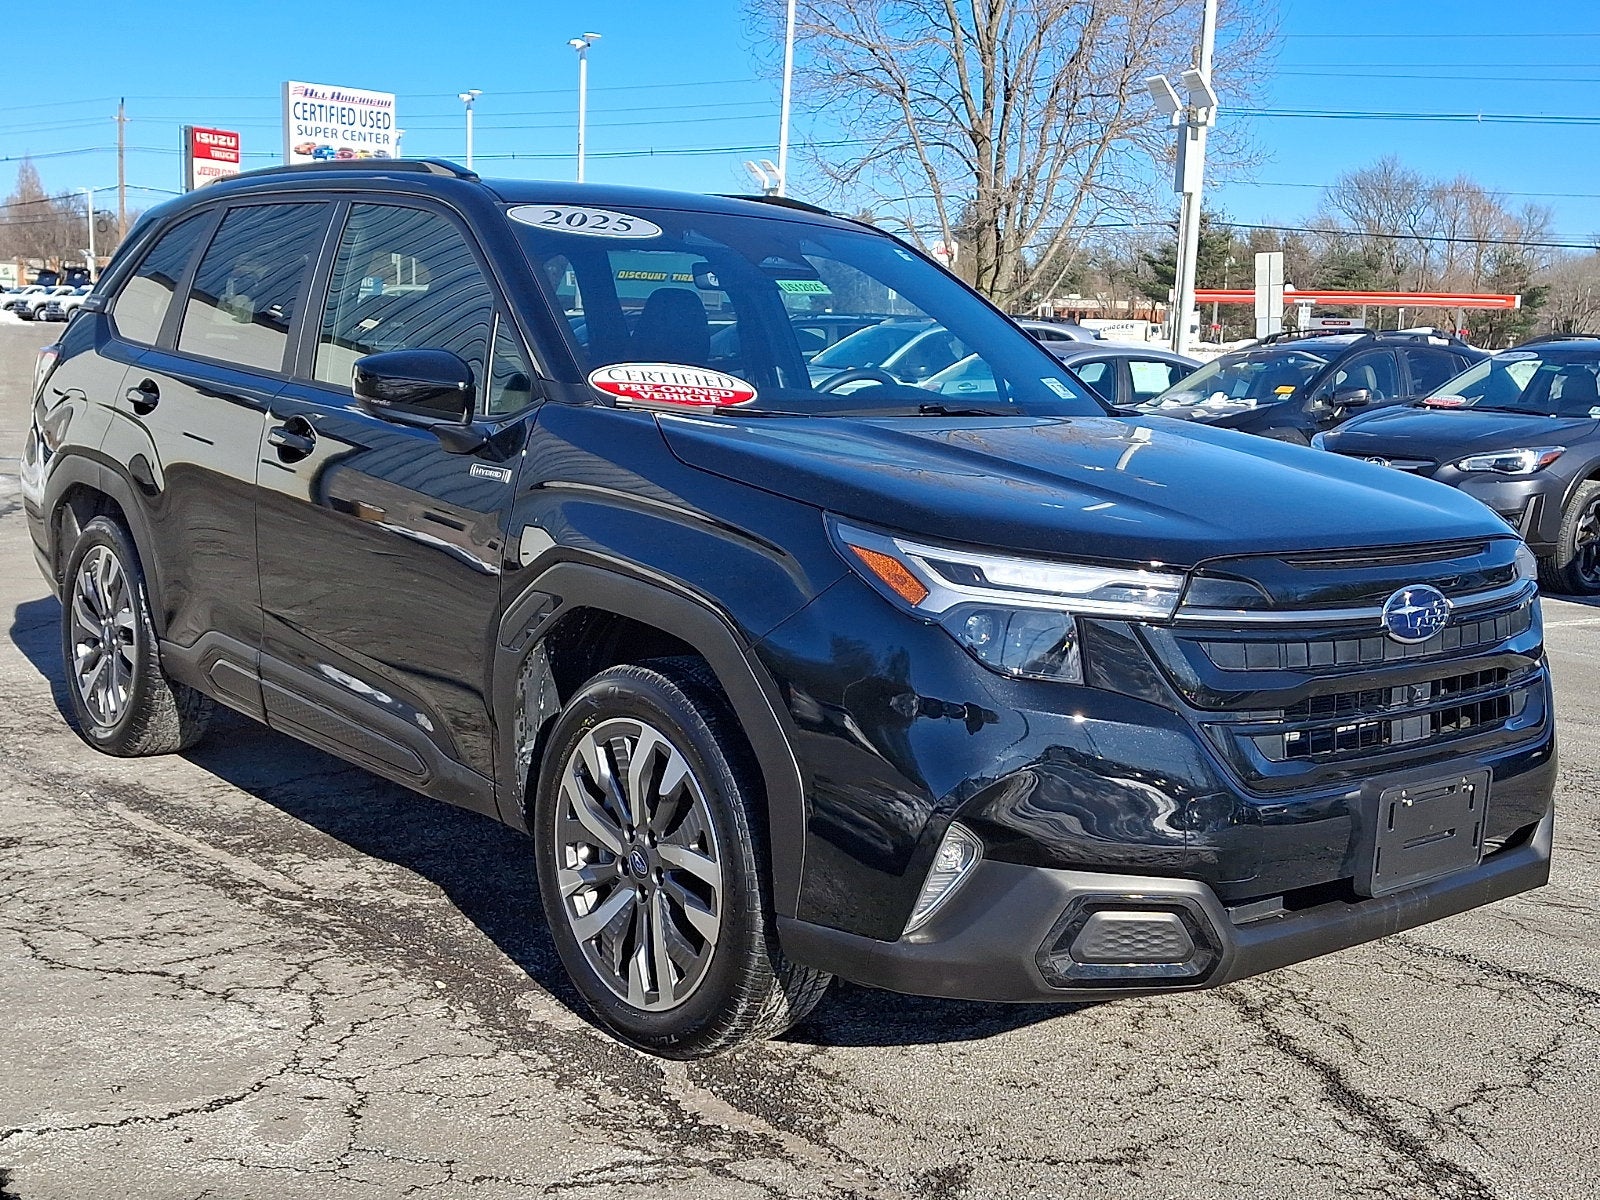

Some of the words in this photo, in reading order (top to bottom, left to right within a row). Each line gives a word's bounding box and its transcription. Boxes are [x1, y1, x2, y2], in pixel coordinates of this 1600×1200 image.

[293, 101, 356, 126] CERTIFIED
[359, 109, 391, 130] USED
[195, 131, 236, 147] ISUZU
[296, 124, 338, 139] SUPER
[342, 129, 390, 145] CENTER
[210, 150, 236, 160] TRUCK
[540, 208, 637, 233] 2025
[617, 269, 668, 282] DISCOUNT
[607, 368, 735, 389] CERTIFIED
[617, 383, 735, 398] PRE-OWNED
[639, 390, 723, 404] VEHICLE
[475, 466, 502, 478] HYBRID
